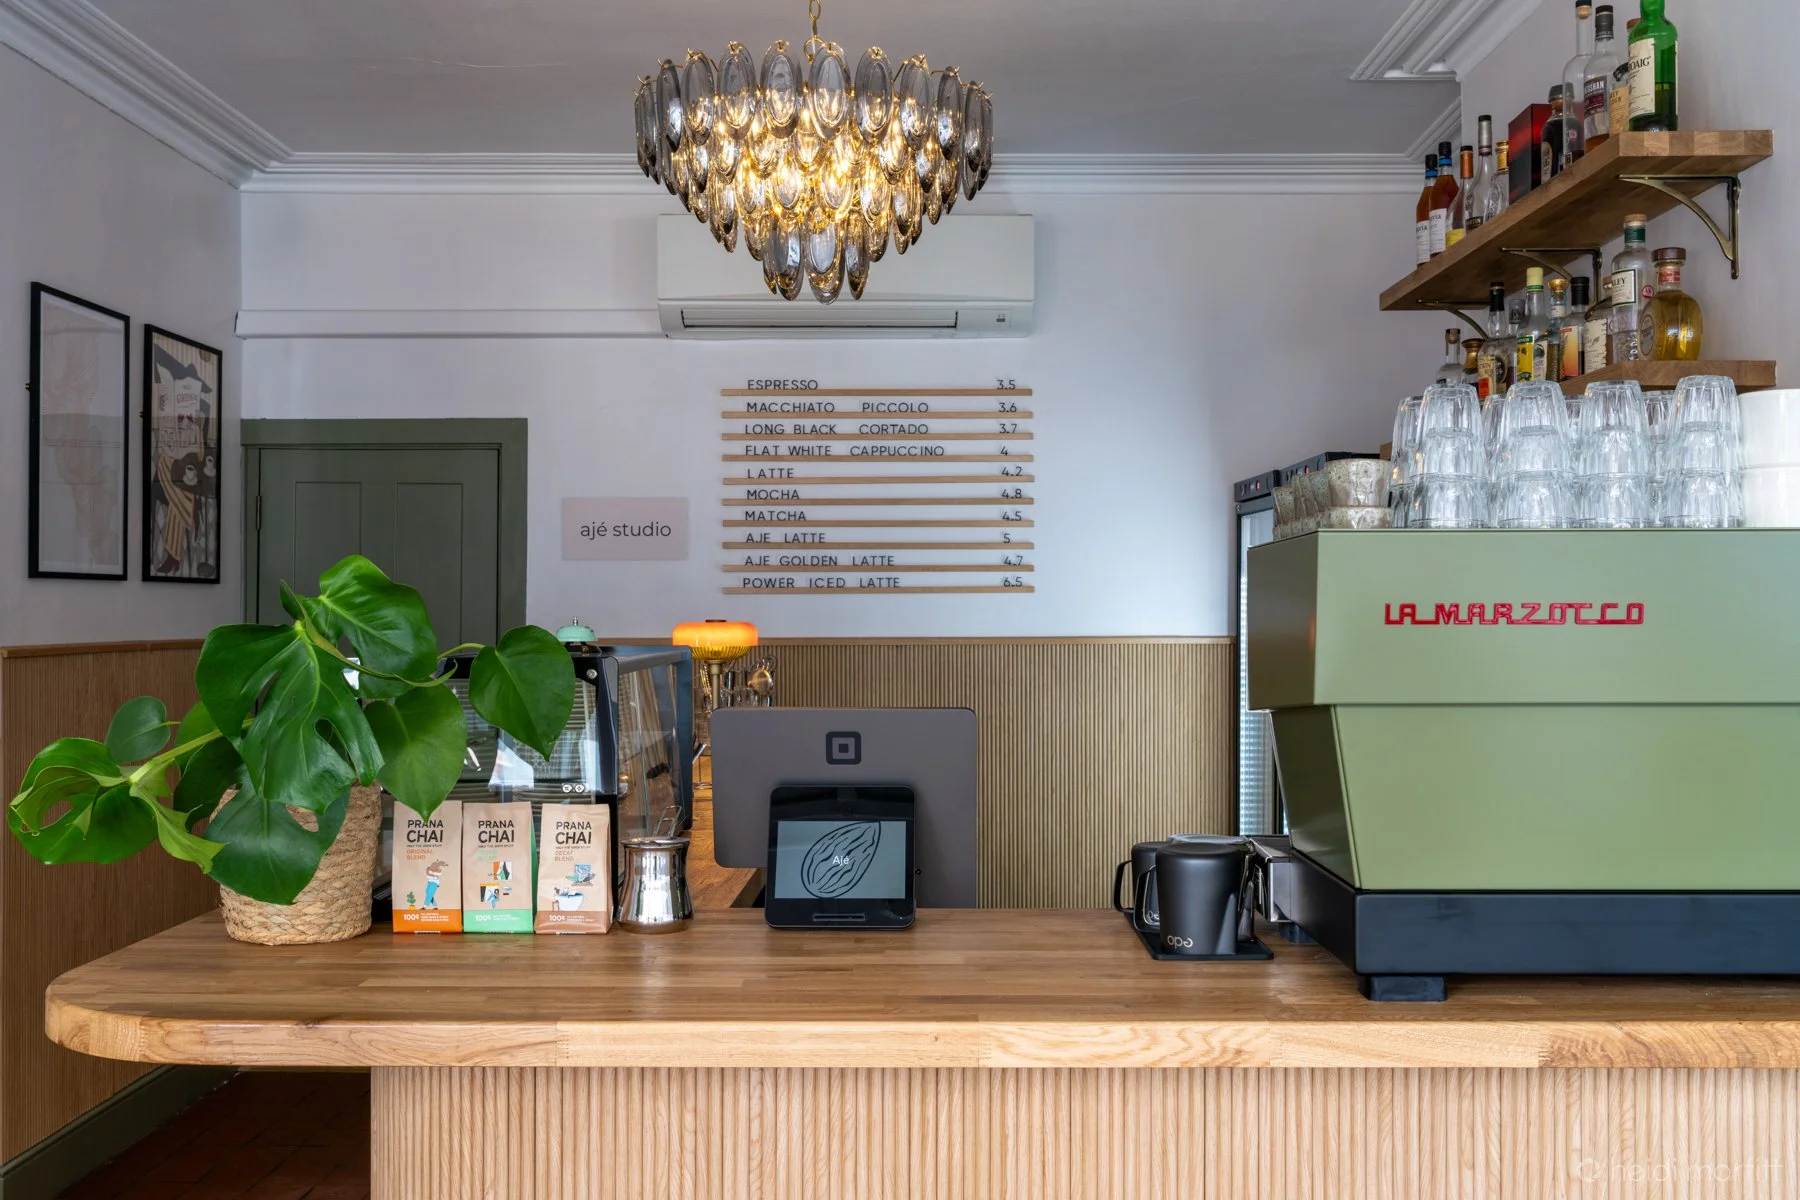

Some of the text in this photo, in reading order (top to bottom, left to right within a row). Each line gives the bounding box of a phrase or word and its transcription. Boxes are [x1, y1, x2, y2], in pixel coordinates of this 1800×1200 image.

[747, 379, 1017, 390] ESPRESSO 3.5
[746, 402, 1018, 413] MACCHIATO PICCOLO 3.6
[745, 424, 1019, 435] LONG BLACK CORTADO 3.7
[745, 445, 1009, 456] FLAT WHITE CAPPUCCINO 4
[747, 466, 1024, 478] LATTE 4.2
[746, 489, 1023, 500] MOCHA 4.8
[745, 511, 1023, 521] MATCHA 4.5
[580, 521, 672, 541] ajé studio
[745, 532, 1011, 543] AJE LATTE 5
[744, 555, 1024, 566] AJE GOLDEN LATTE 4.7
[742, 577, 1023, 588] POWER ICED LATTE 6.5
[1384, 602, 1645, 625] LA MARZOCCO
[407, 819, 444, 829] PRANA
[478, 820, 515, 829] PRANA
[556, 821, 592, 830] PRANA
[406, 829, 444, 843] CHAI
[478, 830, 515, 844] CHAI
[555, 831, 592, 845] CHAI
[832, 855, 850, 866] Ajé
